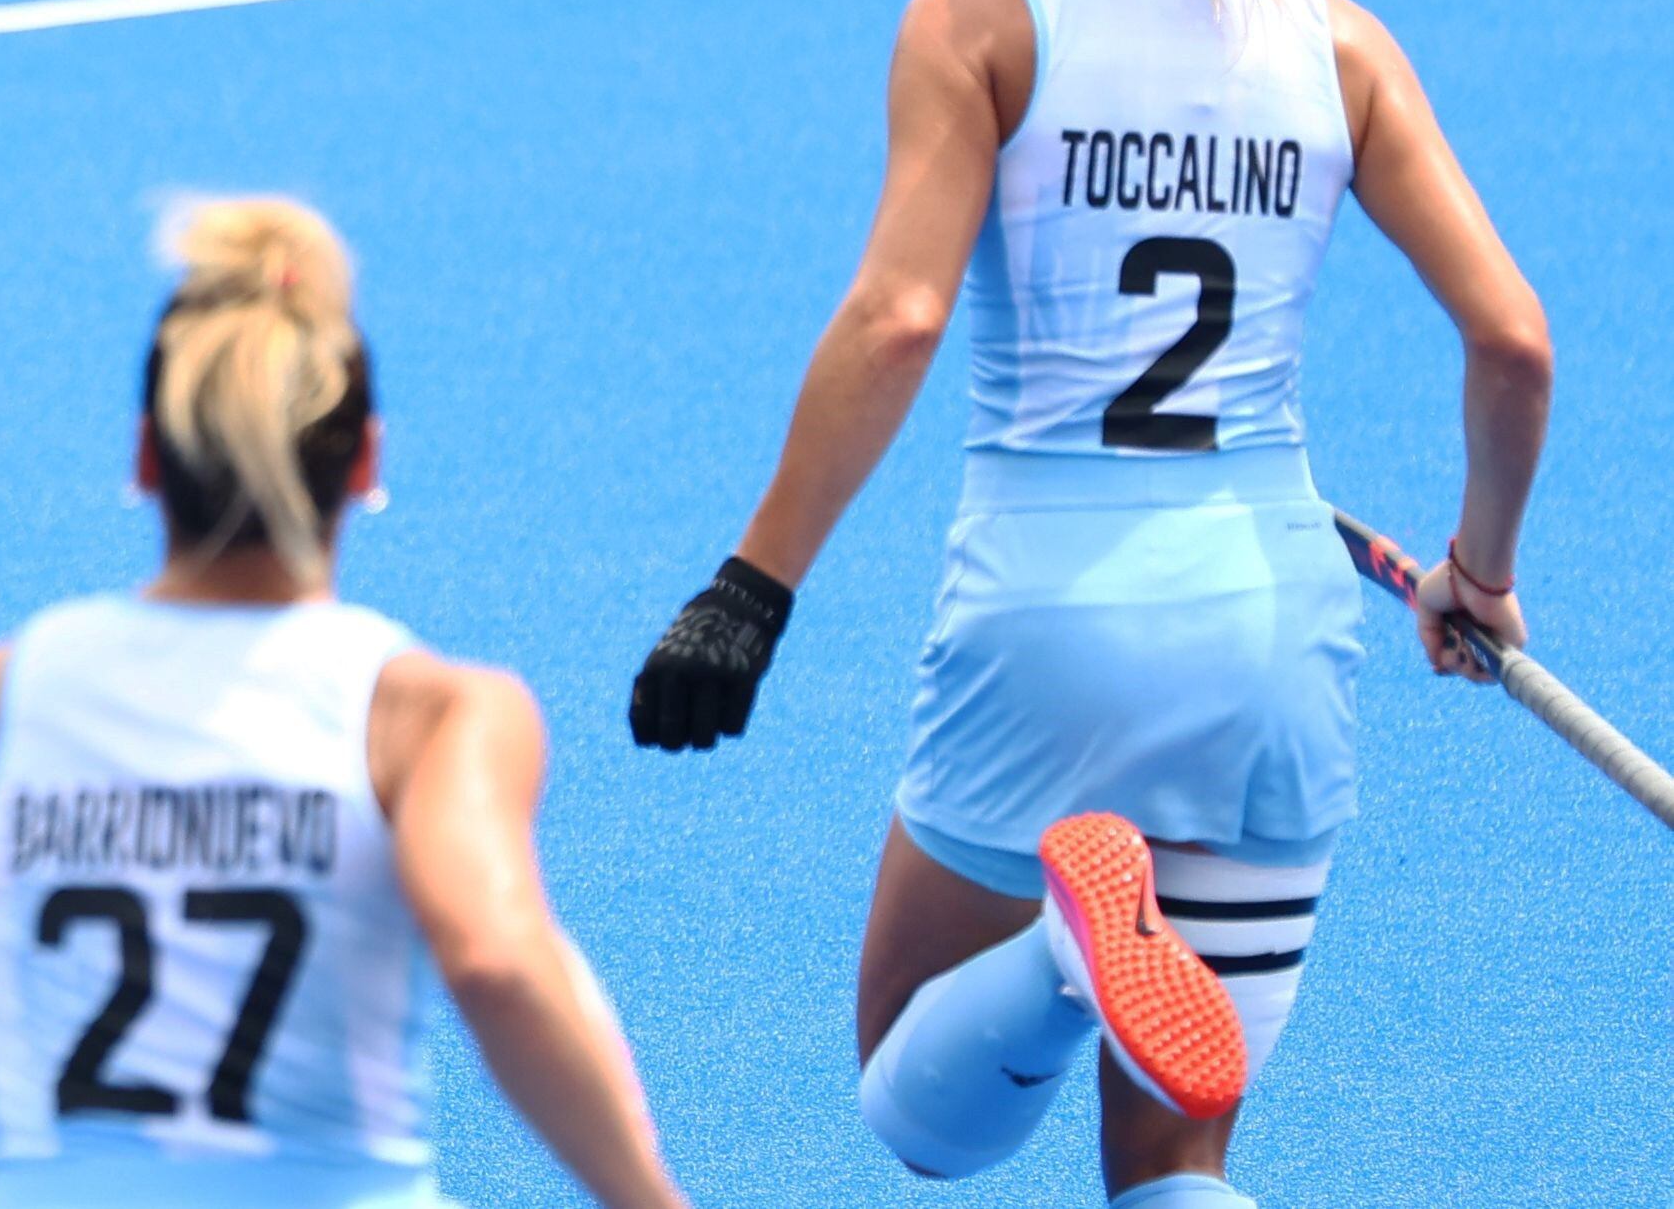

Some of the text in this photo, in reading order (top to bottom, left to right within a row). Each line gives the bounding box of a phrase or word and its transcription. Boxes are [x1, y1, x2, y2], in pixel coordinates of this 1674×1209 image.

[1062, 129, 1302, 217] TOCCALINO
[1102, 235, 1236, 452] 2
[12, 783, 338, 875] BARRIONUEVO
[36, 885, 309, 1122] 27
